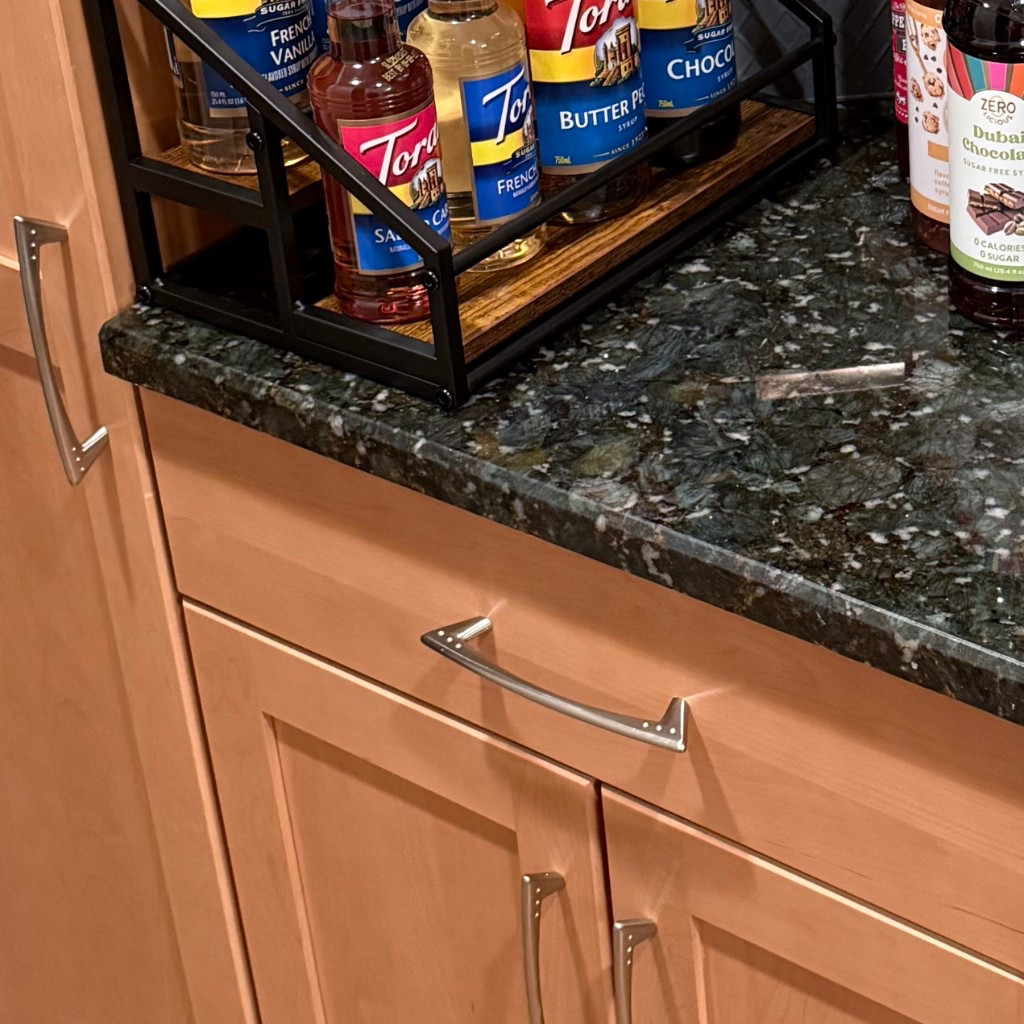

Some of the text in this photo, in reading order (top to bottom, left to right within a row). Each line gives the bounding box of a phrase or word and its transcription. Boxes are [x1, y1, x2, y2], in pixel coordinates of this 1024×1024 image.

[260, 0, 296, 15] SUGAR
[697, 28, 726, 41] SUGAR
[980, 97, 1016, 114] ZERO
[560, 99, 630, 130] BUTTER
[617, 115, 638, 133] SYRUP
[610, 142, 630, 155] SINCE
[963, 158, 987, 172] SUGAR
[988, 166, 1010, 176] FREE
[987, 252, 1020, 263] SUGAR
